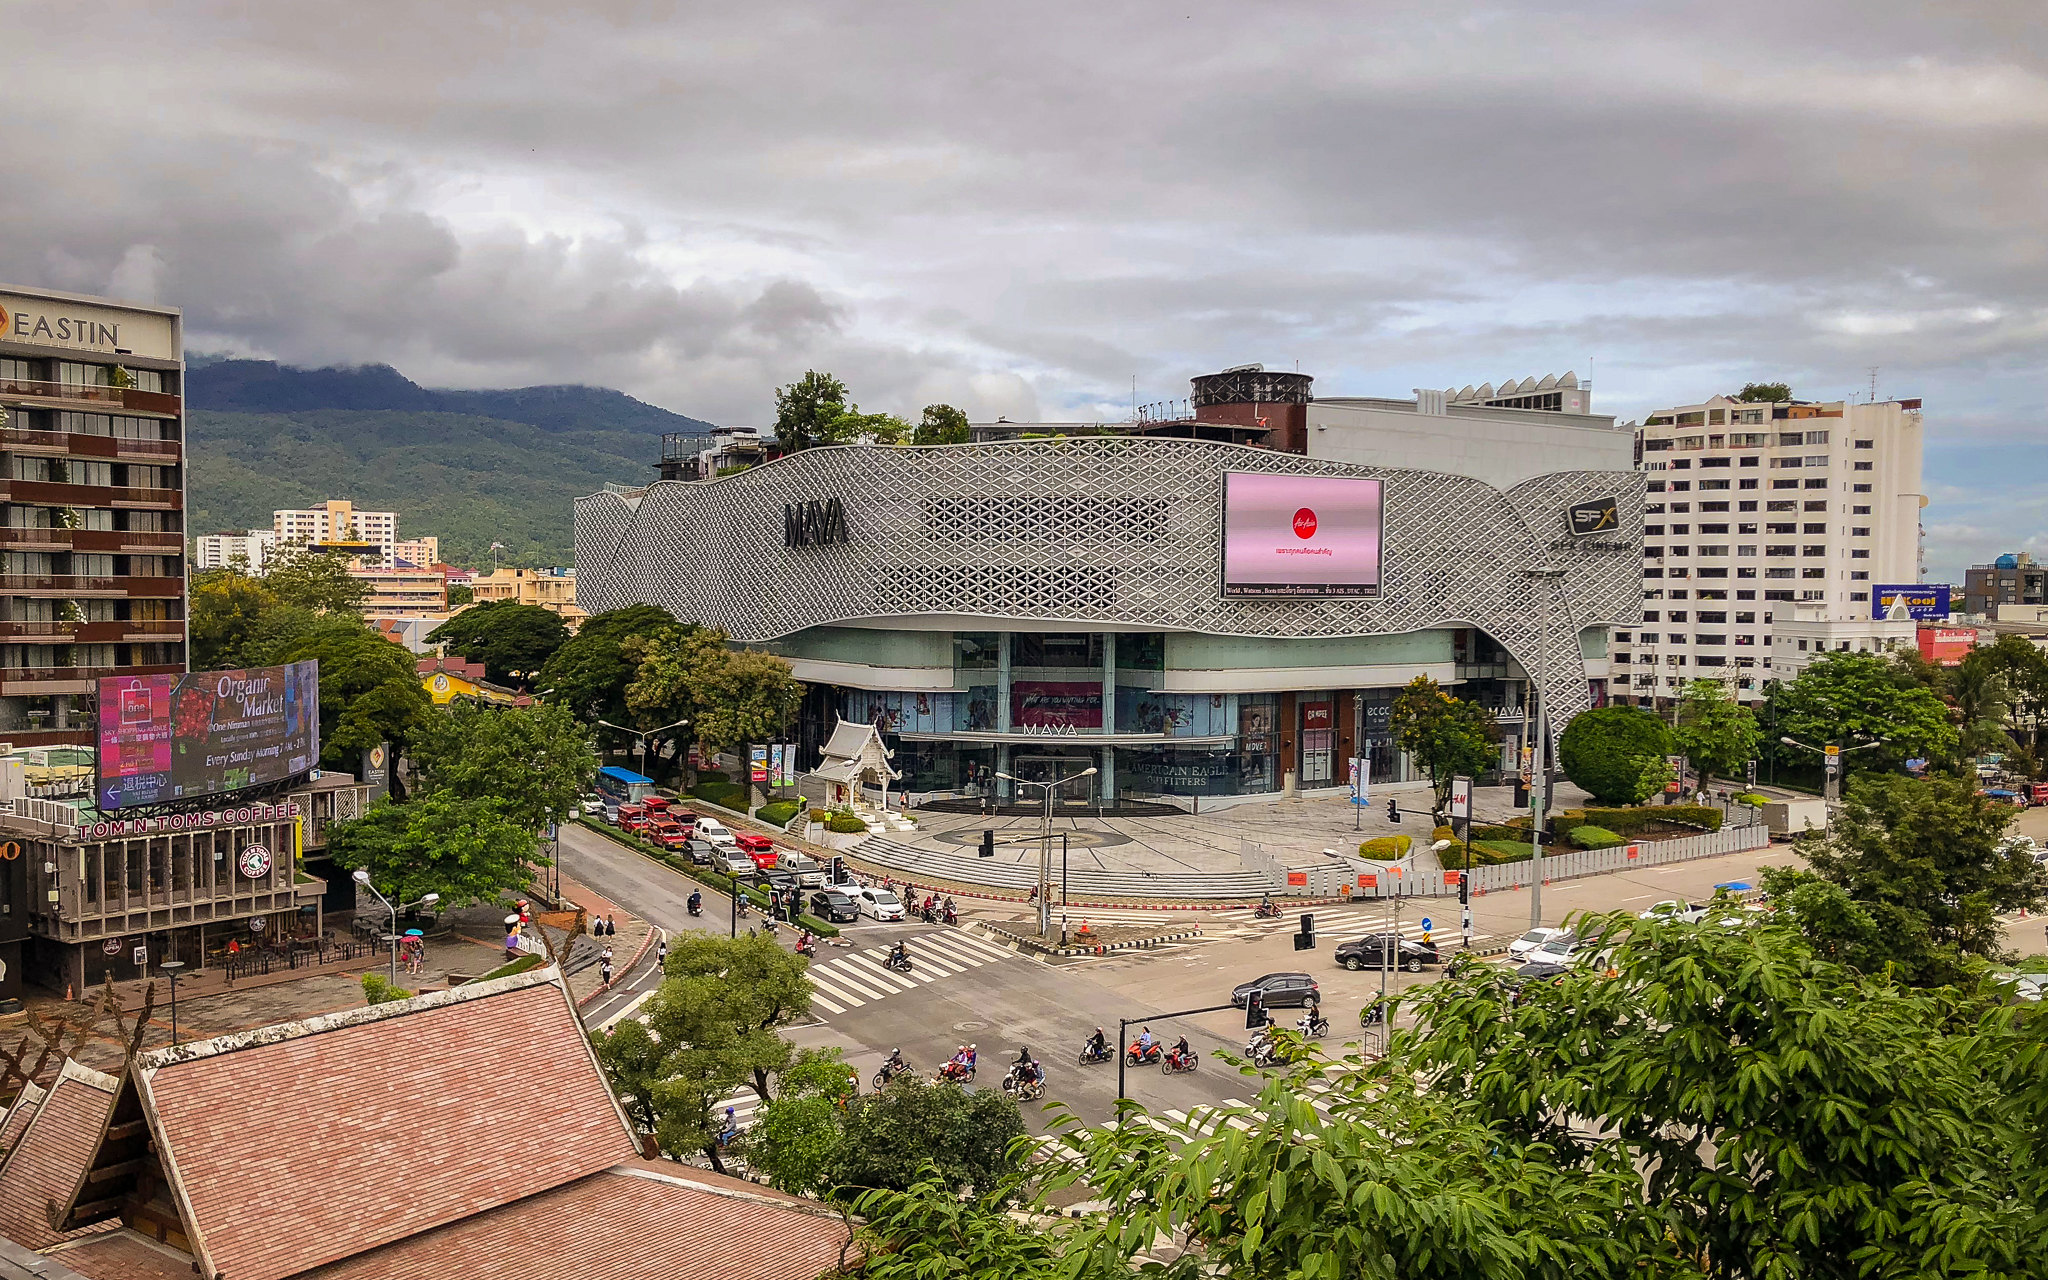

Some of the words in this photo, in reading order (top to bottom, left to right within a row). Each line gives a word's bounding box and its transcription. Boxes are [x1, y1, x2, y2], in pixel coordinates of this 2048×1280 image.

[14, 312, 118, 346] EASTIN
[785, 497, 849, 547] MAYA
[1575, 507, 1616, 530] SFX
[217, 671, 271, 703] Organic
[242, 692, 284, 718] Market
[1488, 706, 1524, 717] MAYA
[1023, 722, 1078, 736] MAYA
[206, 755, 229, 768] Every
[230, 747, 255, 762] Sunday
[1131, 764, 1187, 776] AMERICAN
[1191, 765, 1229, 776] EAGLE
[1147, 775, 1207, 786] OUTFITTERS
[76, 819, 126, 839] TOM
[134, 818, 148, 834] N
[155, 810, 215, 831] TOMS
[222, 803, 300, 824] COFFEE
[242, 851, 251, 865] TOM
[256, 847, 269, 862] TOMS
[243, 864, 268, 876] COFFEE
